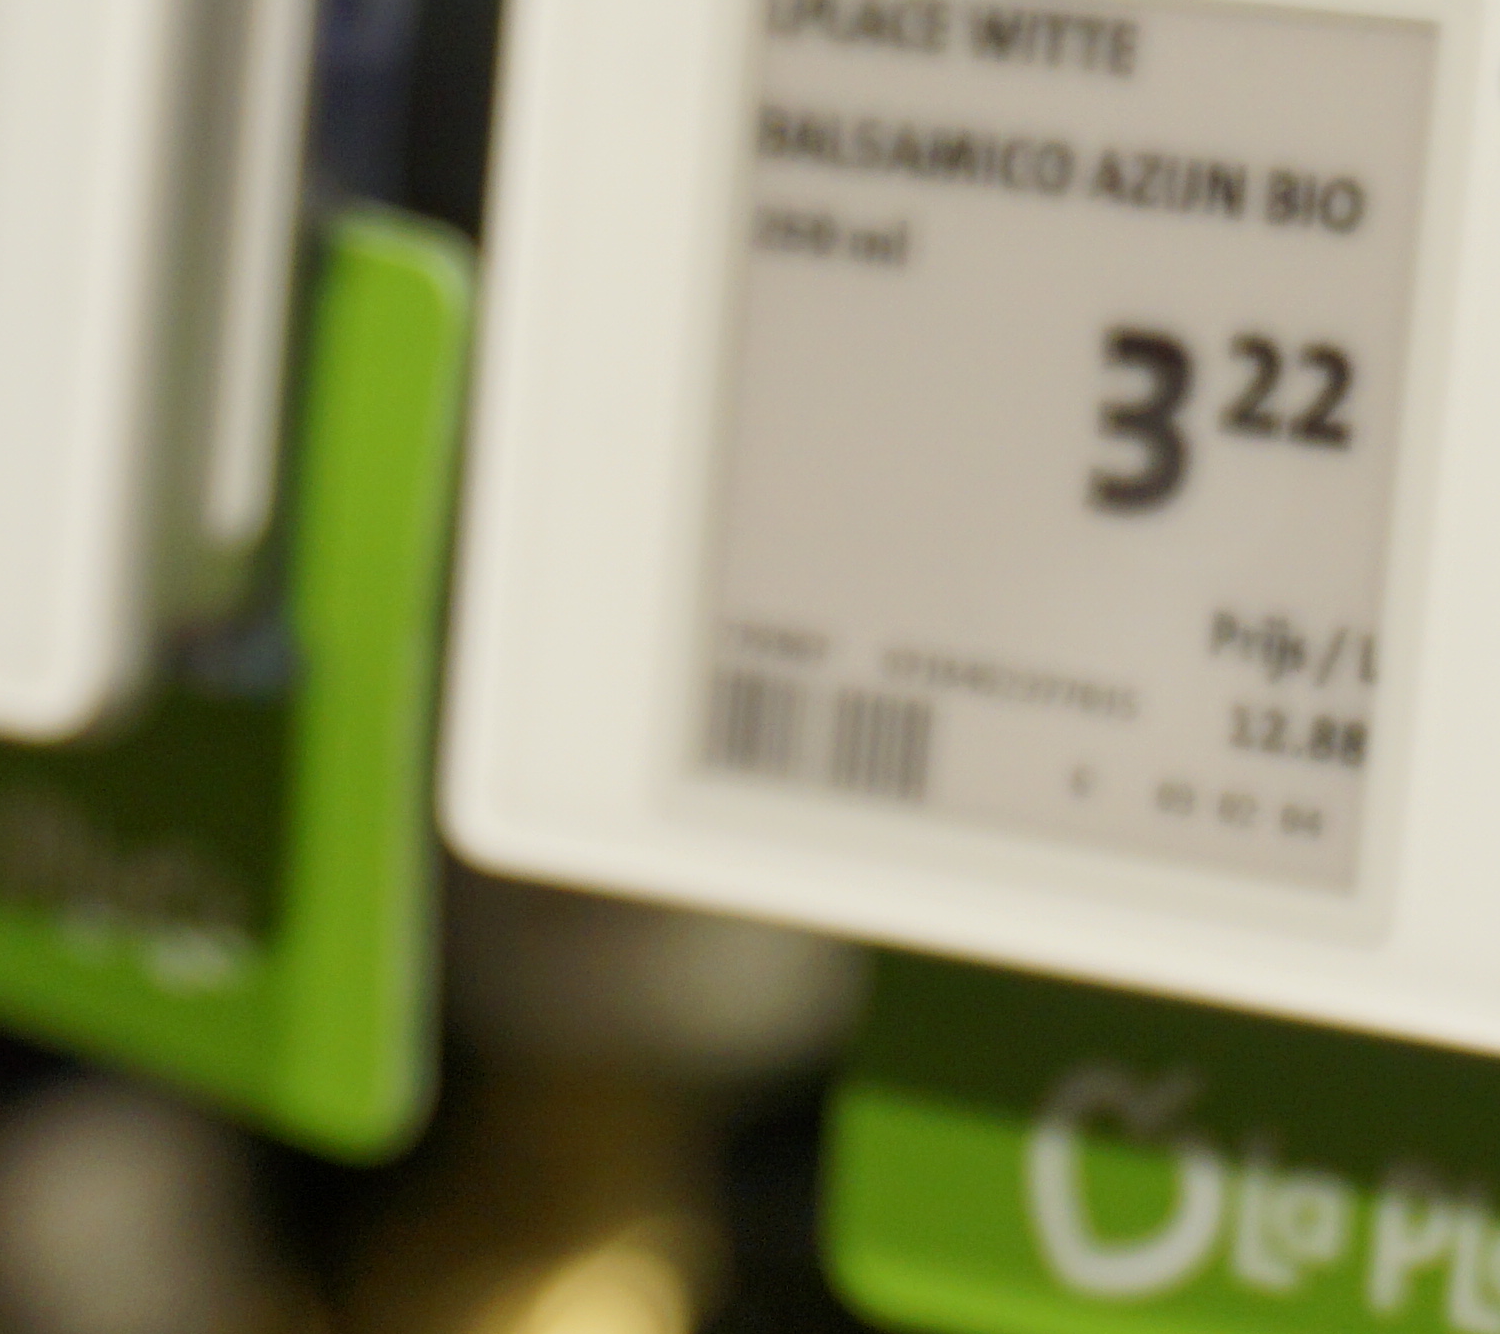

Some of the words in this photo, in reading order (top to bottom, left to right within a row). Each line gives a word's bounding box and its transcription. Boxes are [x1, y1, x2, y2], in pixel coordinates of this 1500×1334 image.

[968, 1, 1141, 80] WITTE
[754, 103, 1075, 199] BALSAMICO
[1263, 165, 1368, 236] BIO
[1083, 322, 1195, 521] 3
